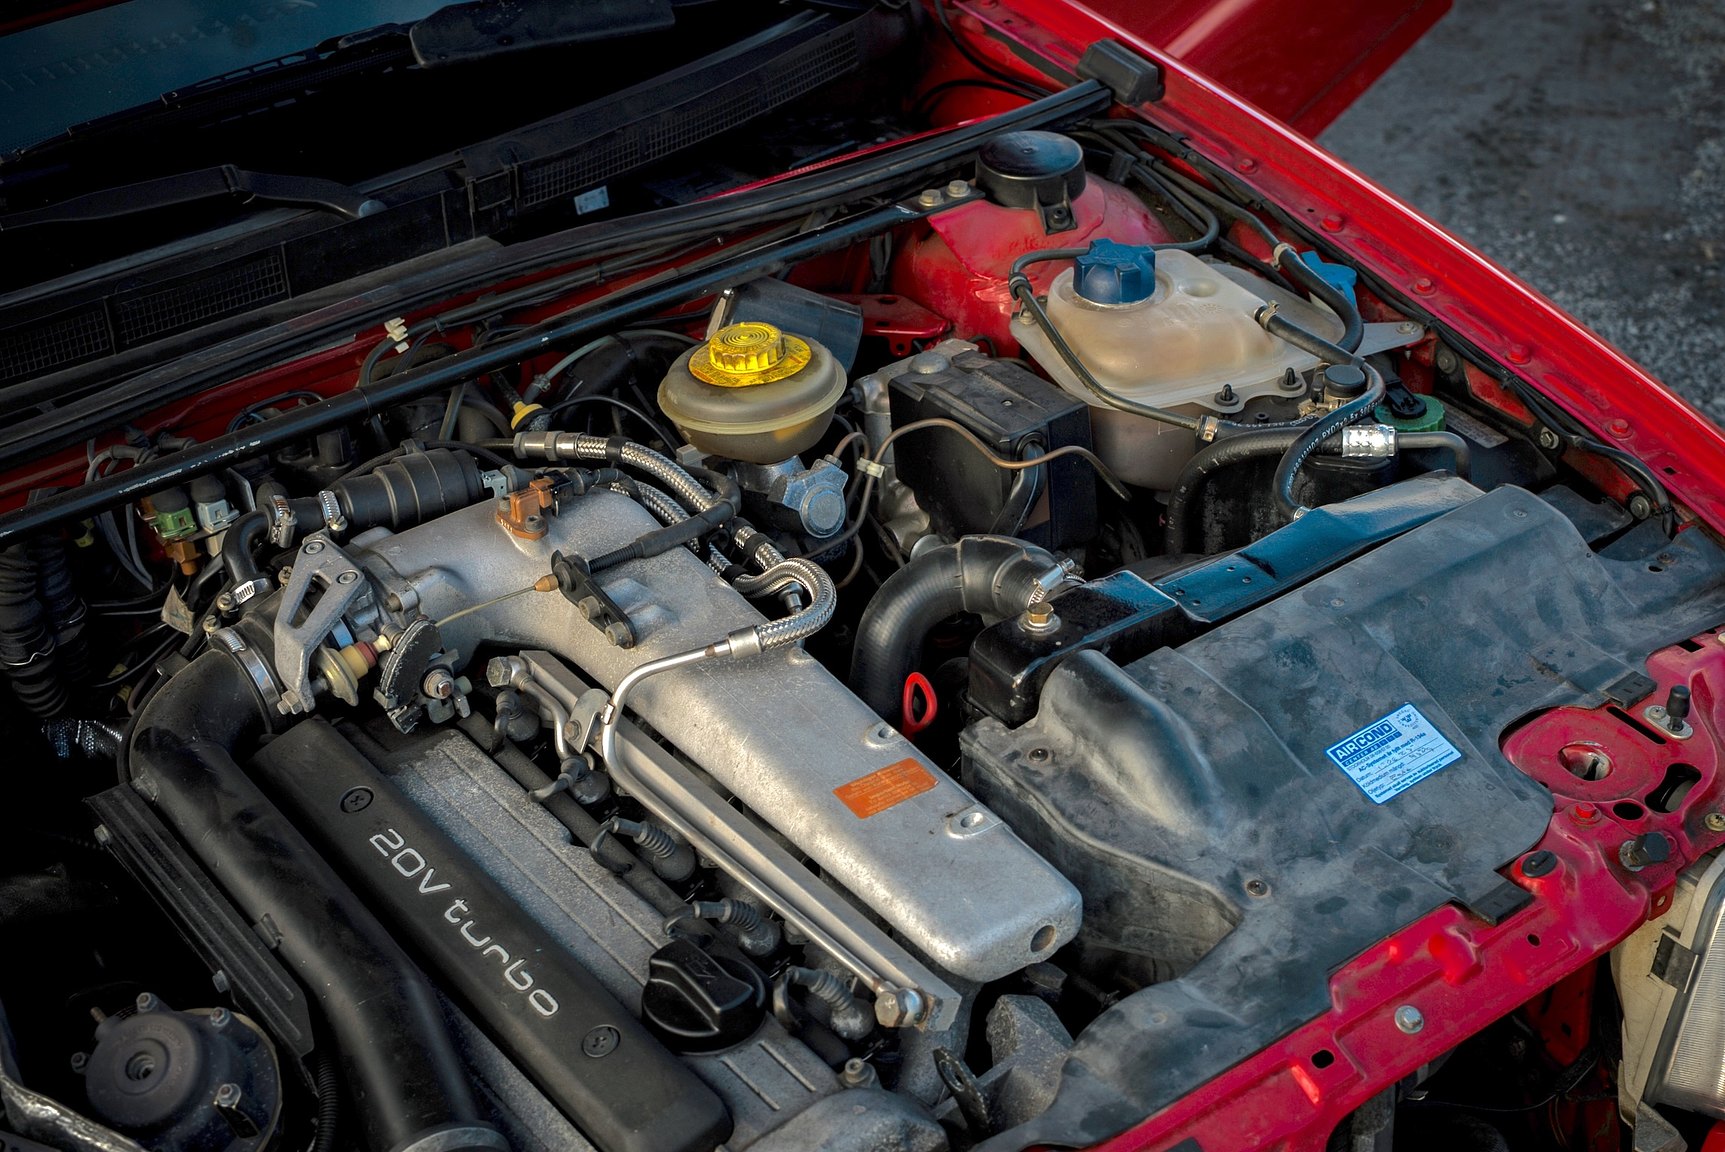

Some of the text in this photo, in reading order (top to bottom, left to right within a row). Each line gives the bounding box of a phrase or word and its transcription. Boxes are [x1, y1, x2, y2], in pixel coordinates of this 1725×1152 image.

[1344, 750, 1369, 766] CENTER
[369, 828, 559, 1017] 20V turbo
